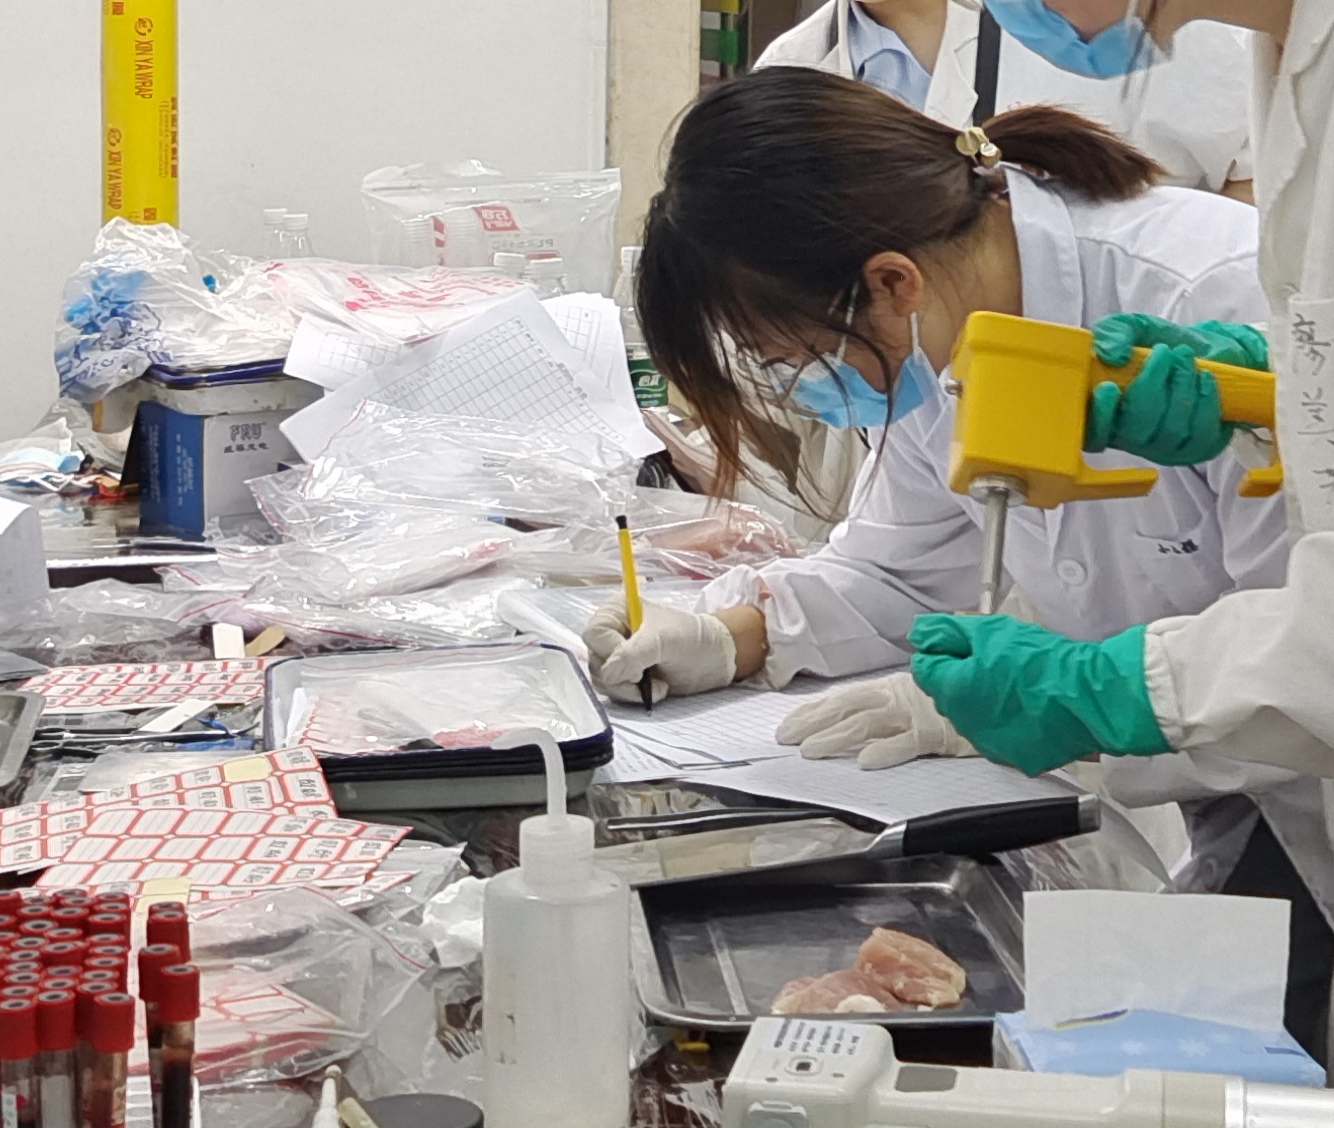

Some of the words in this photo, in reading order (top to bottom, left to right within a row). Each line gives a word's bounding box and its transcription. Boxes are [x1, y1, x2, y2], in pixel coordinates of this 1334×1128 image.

[134, 38, 154, 56] XIN
[134, 57, 154, 71] YA
[134, 71, 153, 99] WRAP
[107, 149, 122, 166] XIN
[107, 167, 123, 181] YA
[107, 181, 122, 210] WRAP
